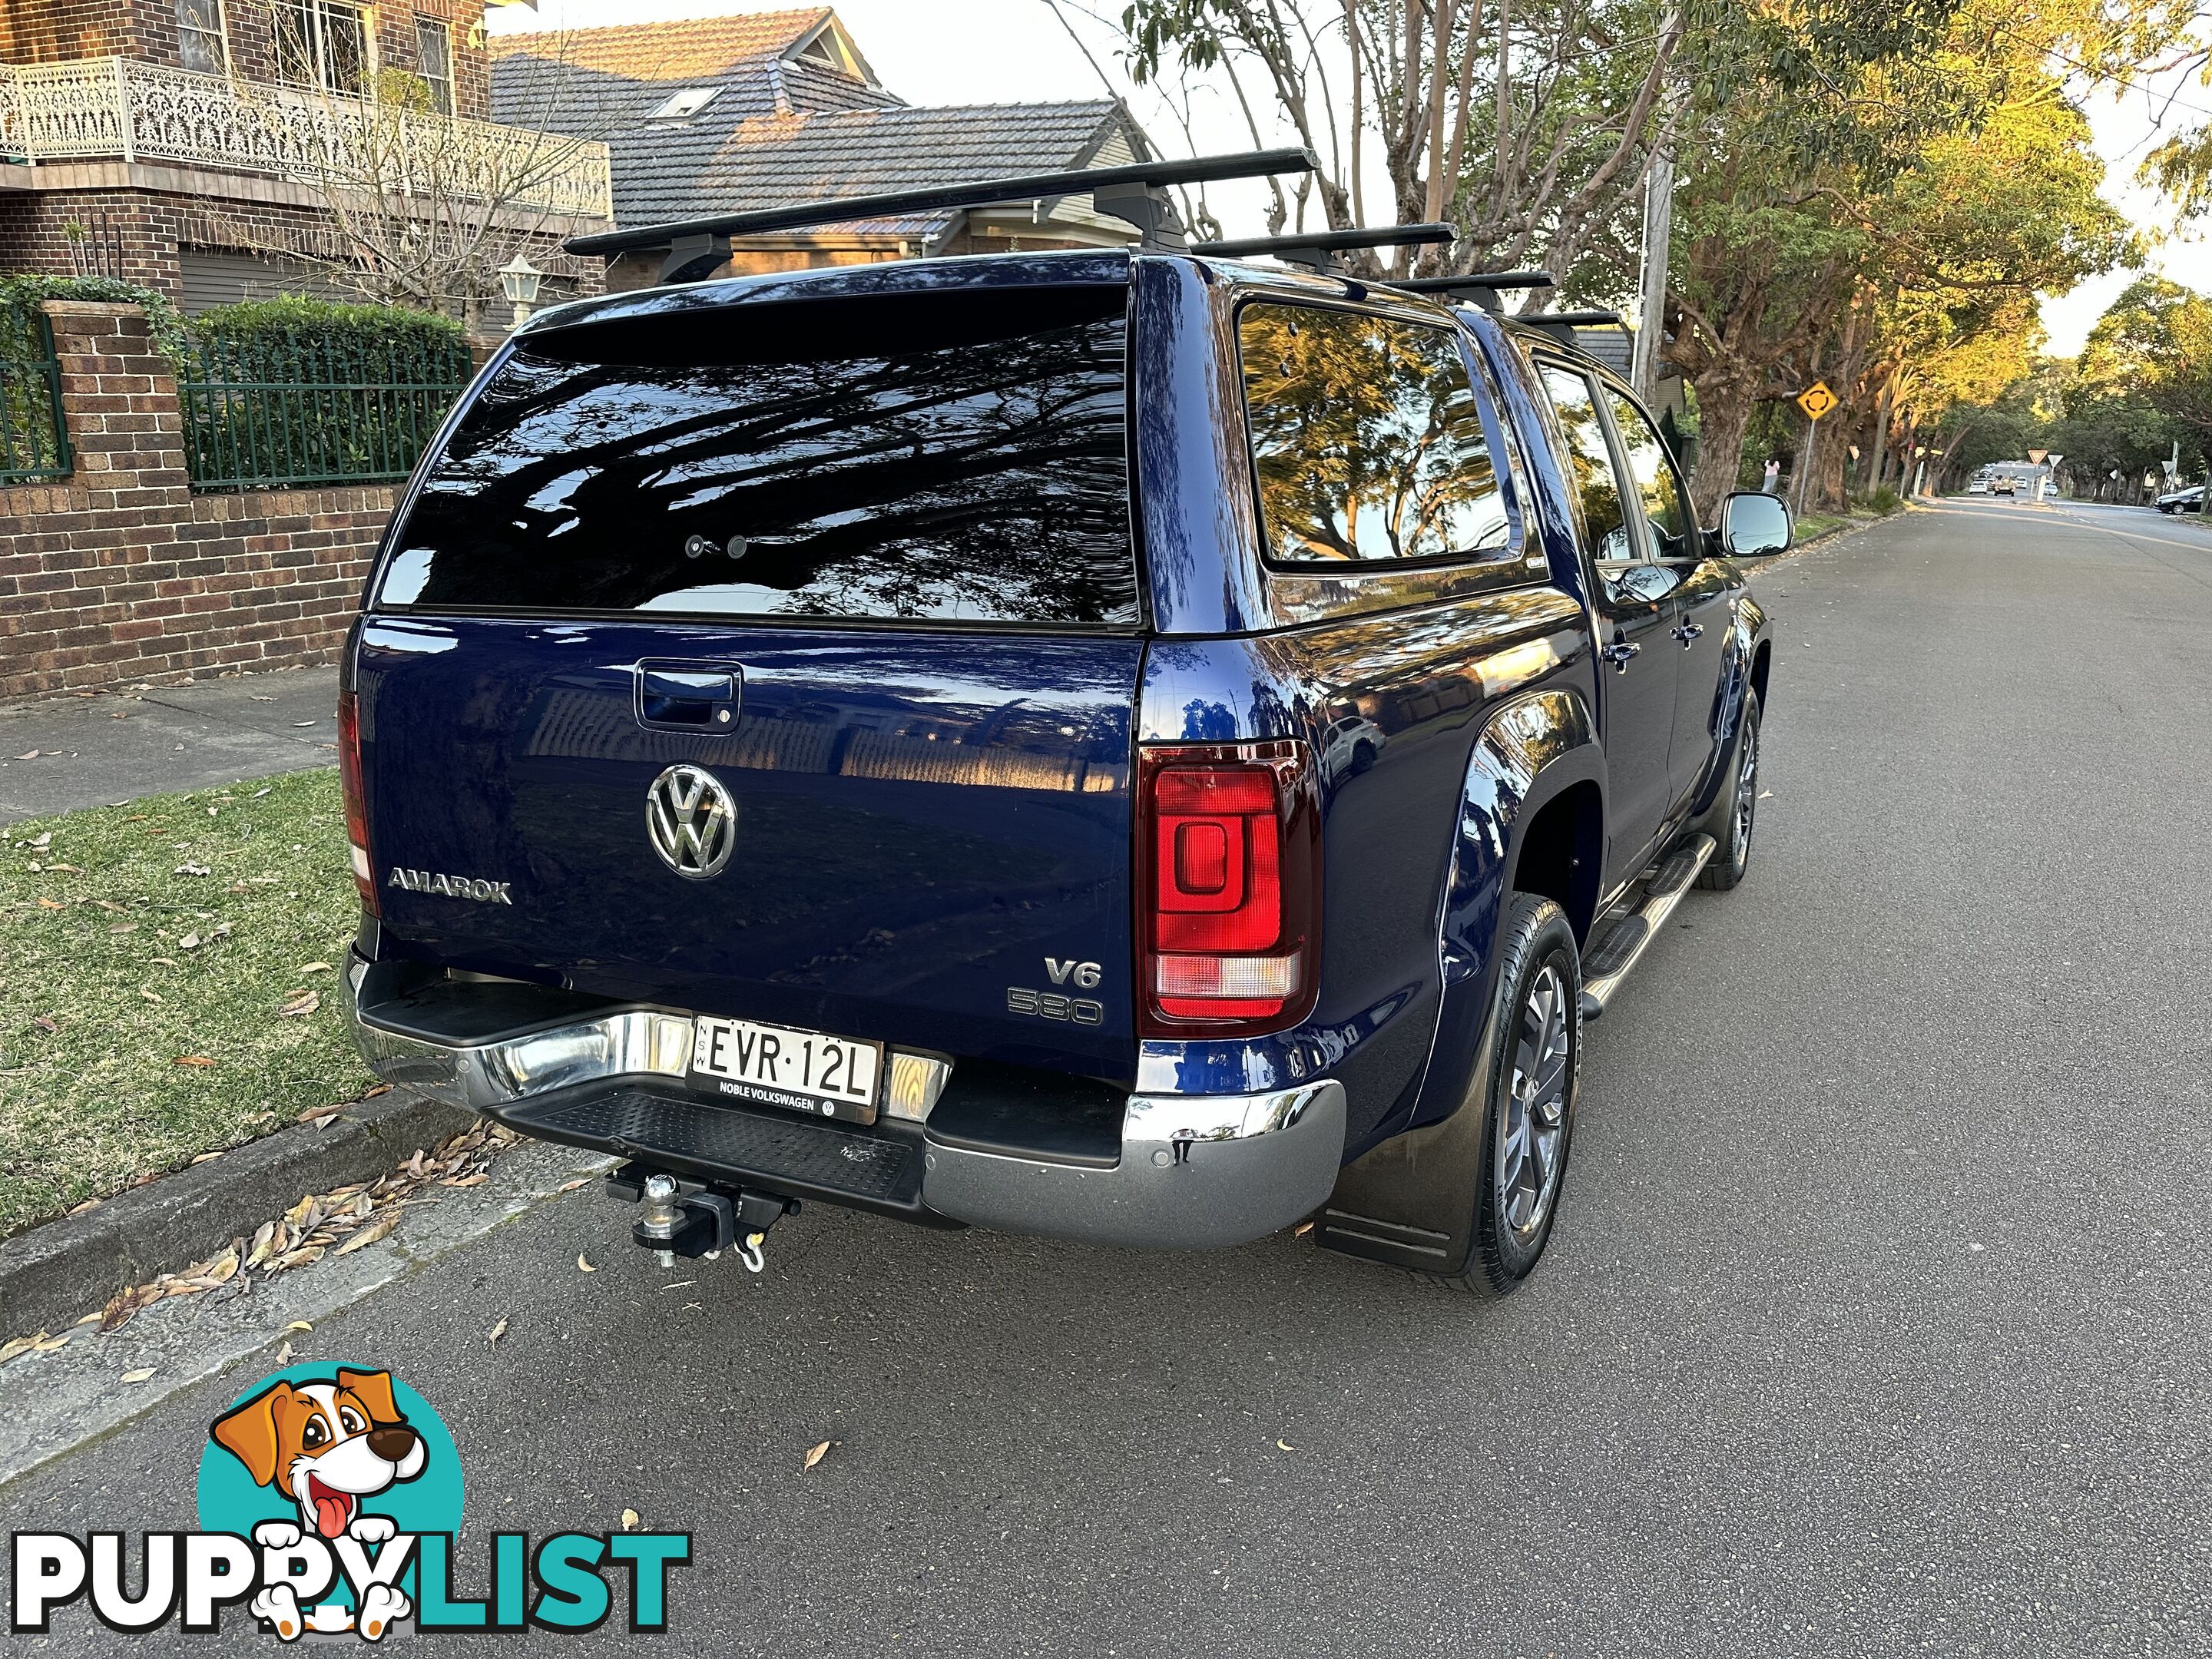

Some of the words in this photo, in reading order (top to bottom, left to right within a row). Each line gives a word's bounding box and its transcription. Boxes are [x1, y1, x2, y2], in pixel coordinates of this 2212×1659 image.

[388, 867, 512, 905] AMAROK
[1045, 957, 1101, 988] V6
[1008, 987, 1103, 1026] 580
[720, 1081, 750, 1098] NOBLE
[750, 1088, 814, 1111] VOLKSWAGEN
